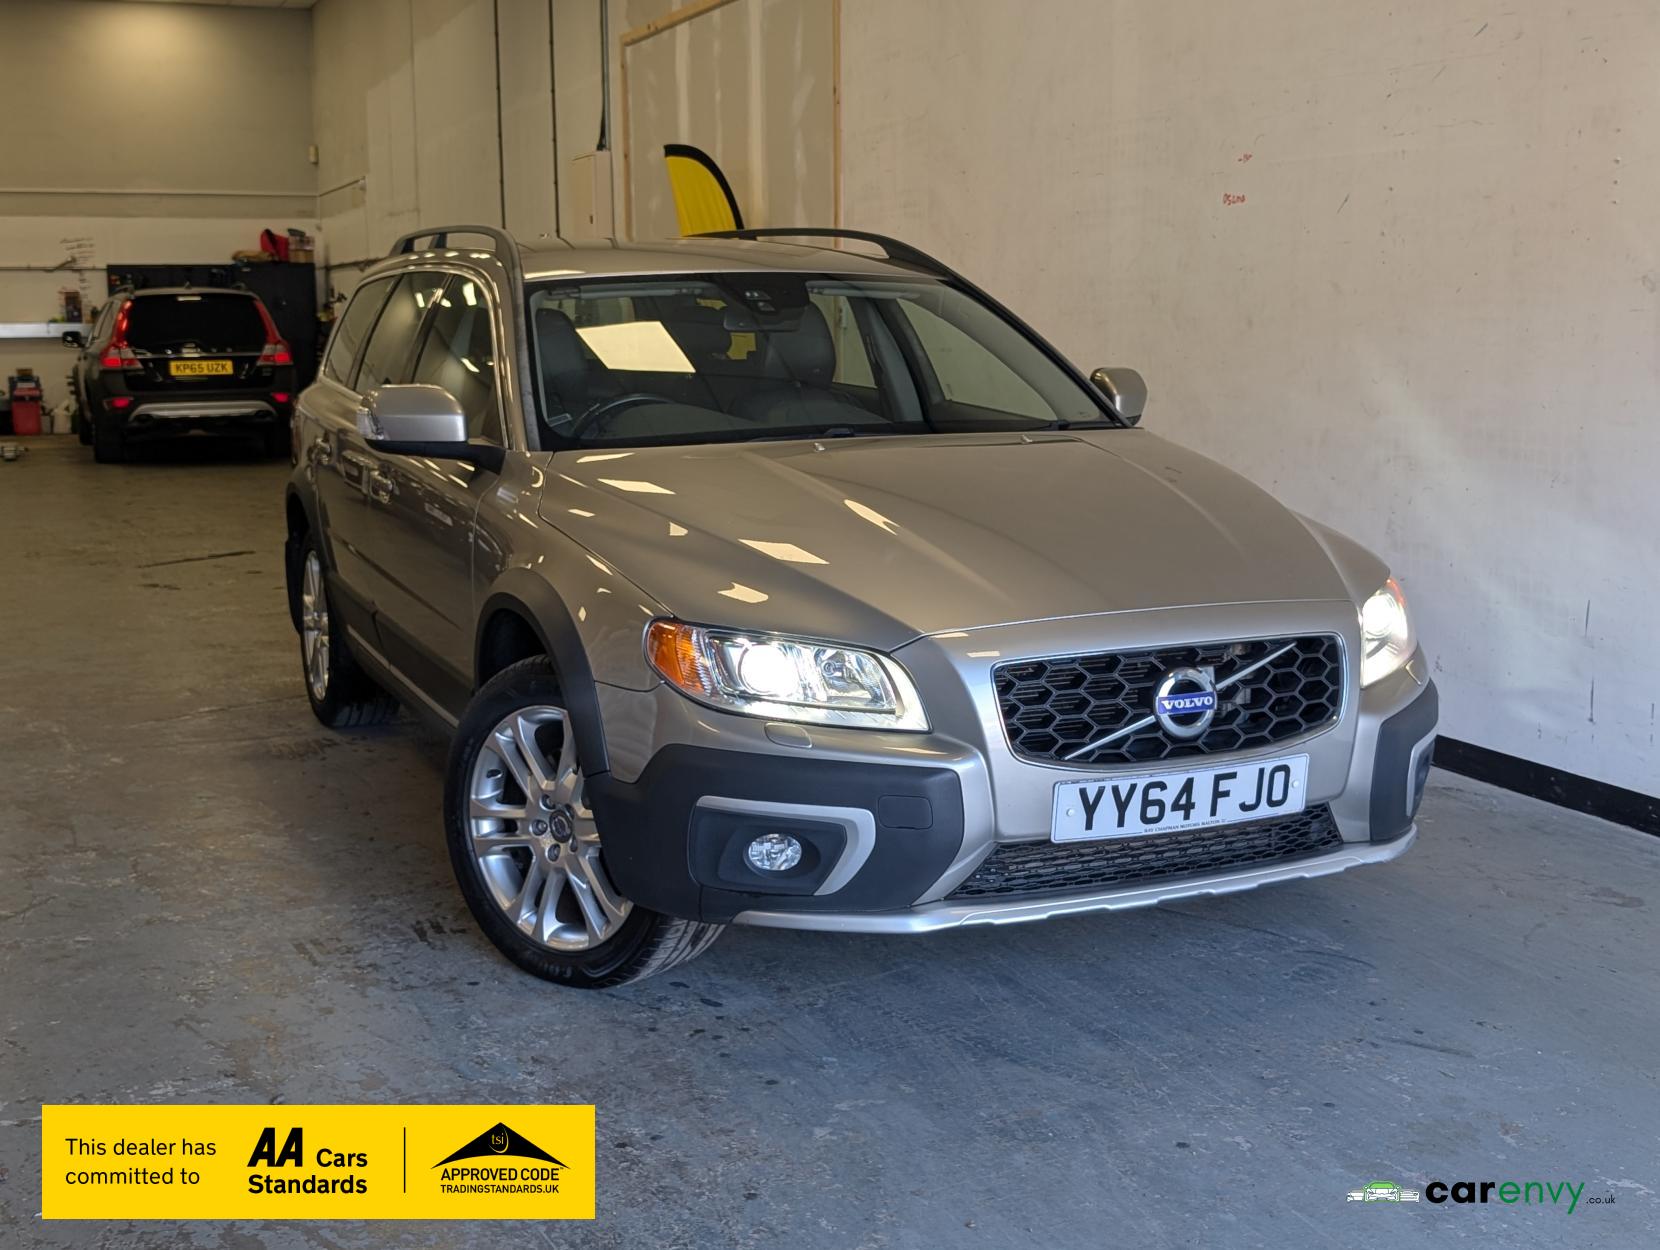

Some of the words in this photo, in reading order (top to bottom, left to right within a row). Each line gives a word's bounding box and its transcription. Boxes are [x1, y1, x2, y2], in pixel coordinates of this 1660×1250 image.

[175, 363, 205, 373] KP65
[207, 362, 229, 373] UZK
[1161, 696, 1213, 710] VOLVO
[1078, 776, 1196, 831] YY64
[1209, 763, 1291, 818] FJO
